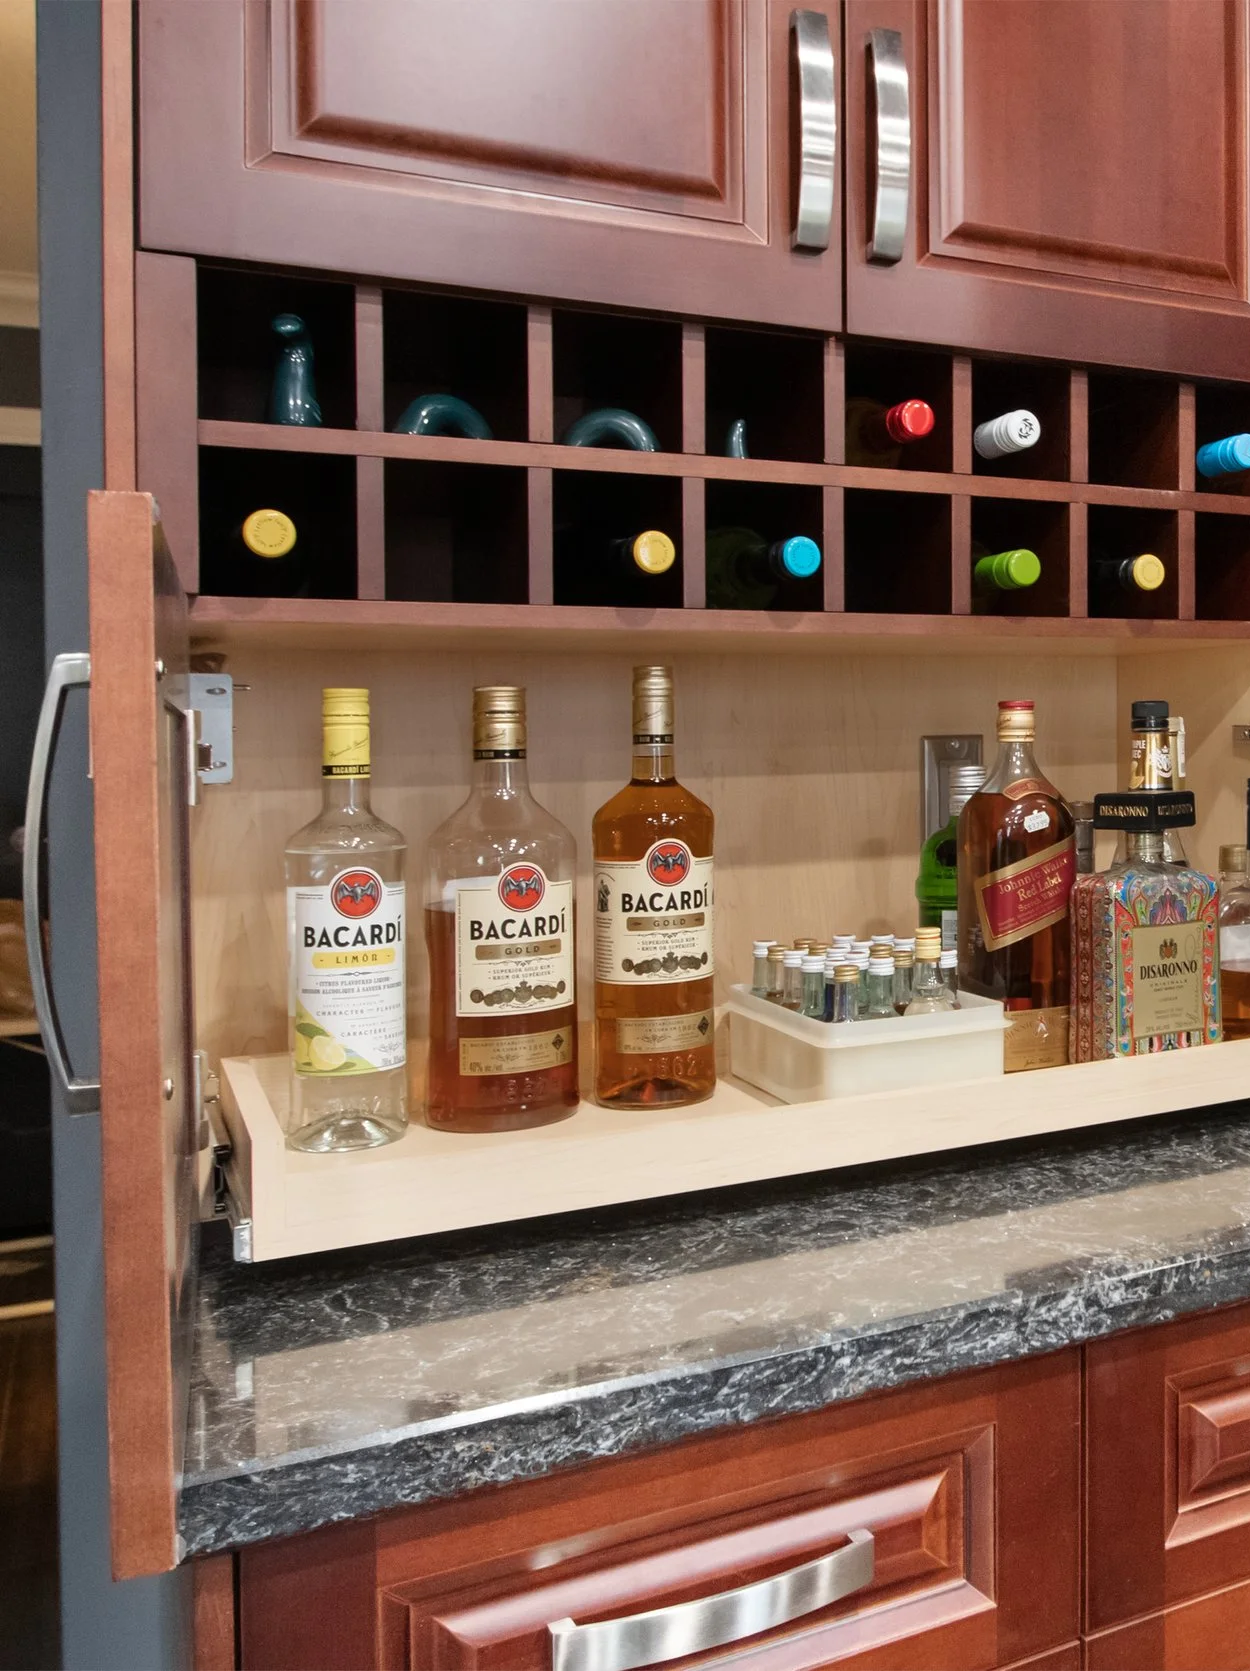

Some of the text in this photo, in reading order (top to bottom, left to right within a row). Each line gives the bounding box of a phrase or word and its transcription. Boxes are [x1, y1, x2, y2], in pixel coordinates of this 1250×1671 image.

[1100, 805, 1149, 817] DISARONNO
[999, 869, 1041, 896] Johnnie
[1017, 873, 1062, 902] Red Label
[621, 882, 708, 913] BACARDÍ
[303, 914, 402, 948] BACARDÍ
[470, 907, 566, 940] BACARDÍ
[653, 919, 686, 928] GOLD
[504, 945, 541, 956] GOLD
[1140, 960, 1198, 981] DISARONNO
